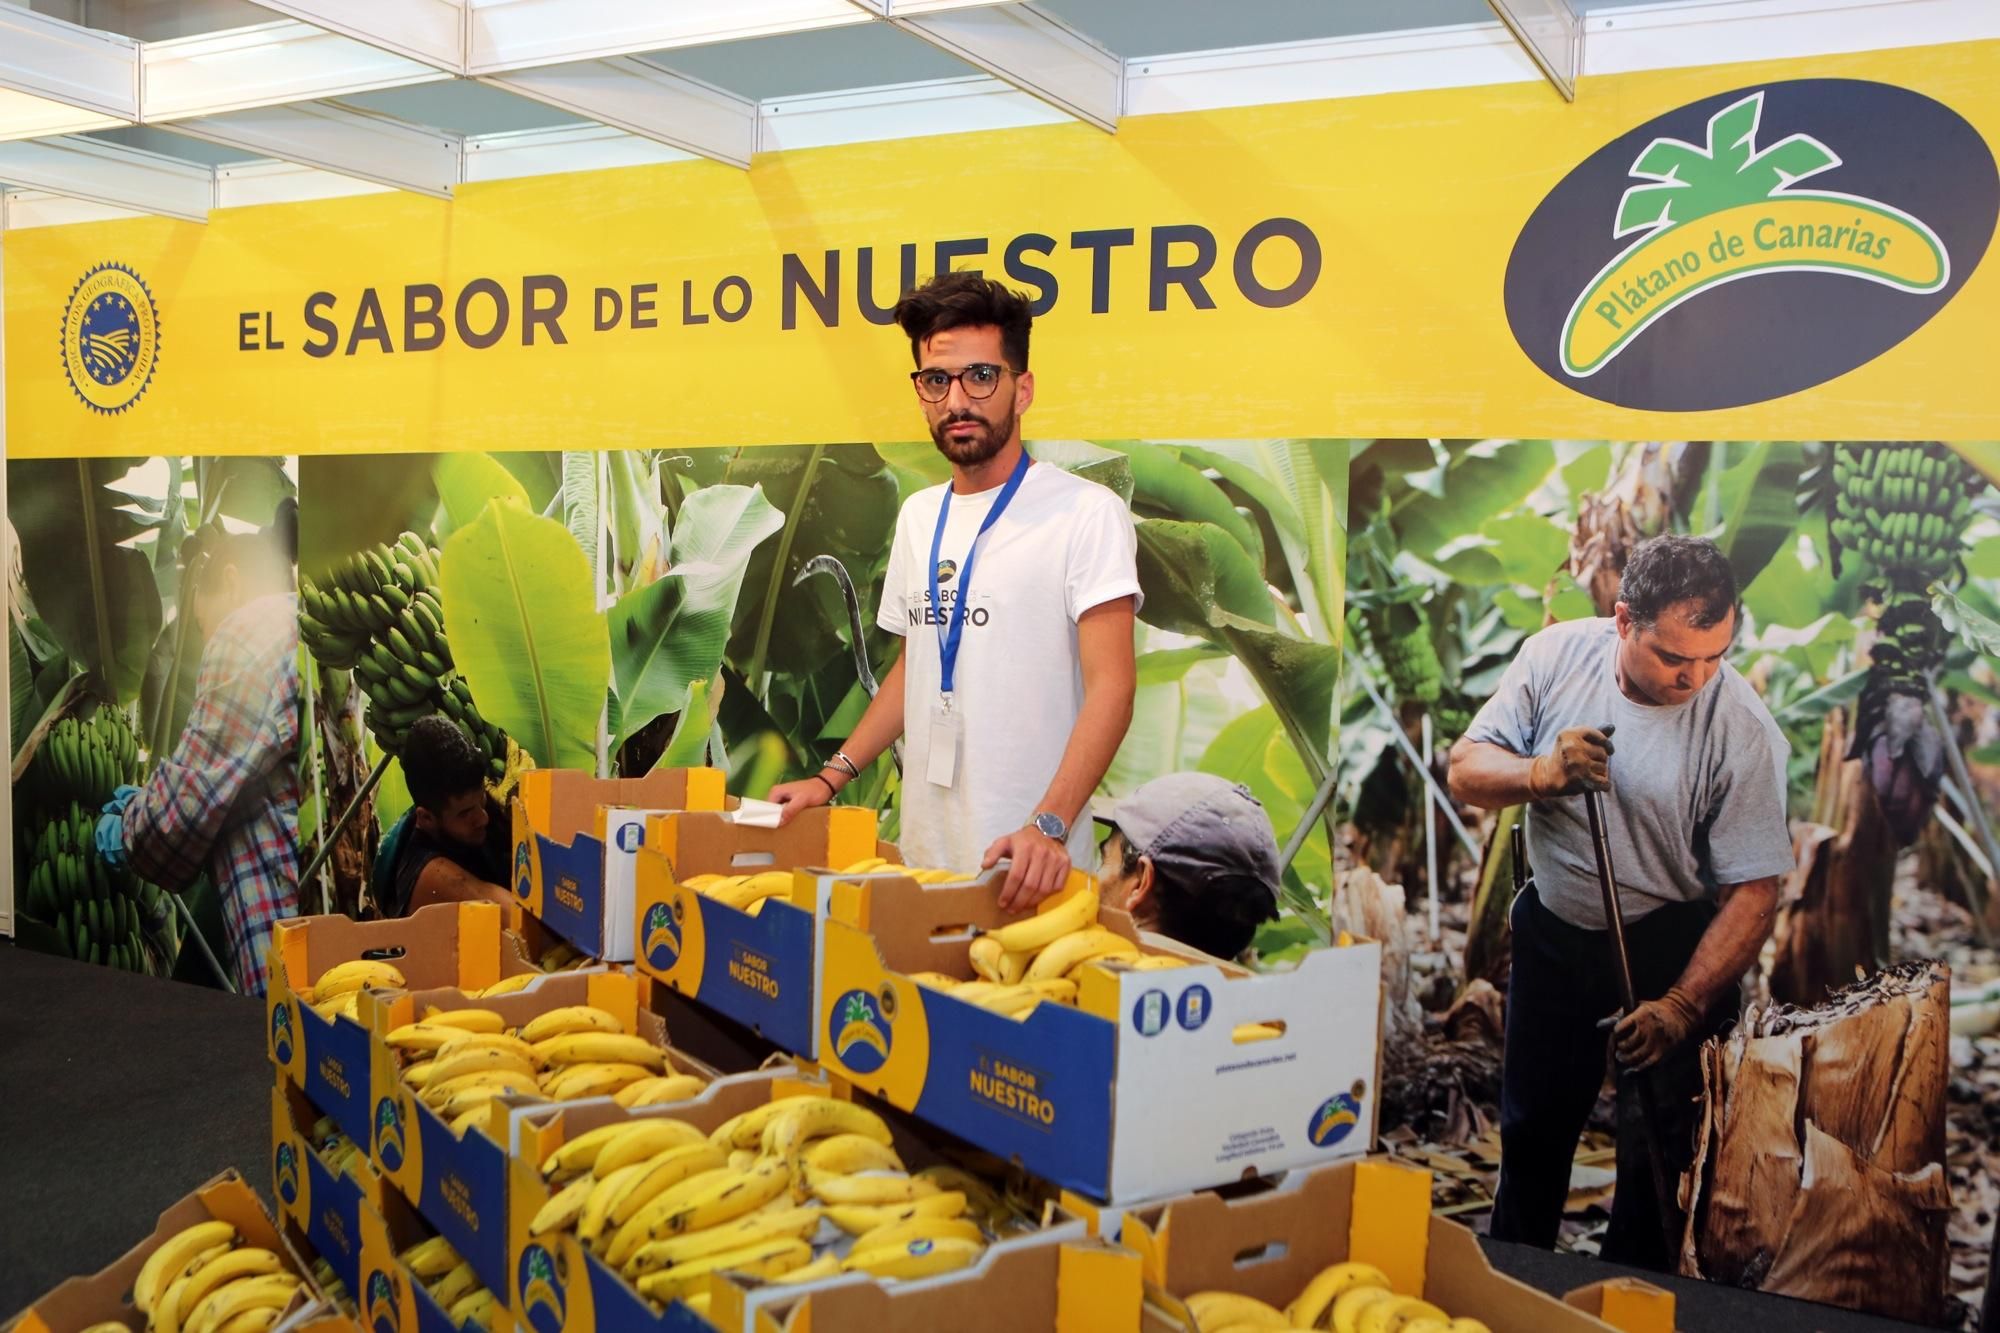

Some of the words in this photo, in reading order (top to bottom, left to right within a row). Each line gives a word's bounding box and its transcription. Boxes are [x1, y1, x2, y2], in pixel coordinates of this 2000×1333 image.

[1595, 250, 1701, 330] Plátano
[1708, 230, 1745, 264] de
[1753, 217, 1891, 261] Canarias
[238, 311, 285, 351] EL
[302, 273, 569, 358] SABOR
[594, 282, 659, 331] DE
[682, 274, 753, 325] LO
[729, 959, 779, 999] NUESTRO
[970, 1068, 1055, 1125] NUESTRO
[994, 1059, 1036, 1092] SABOR
